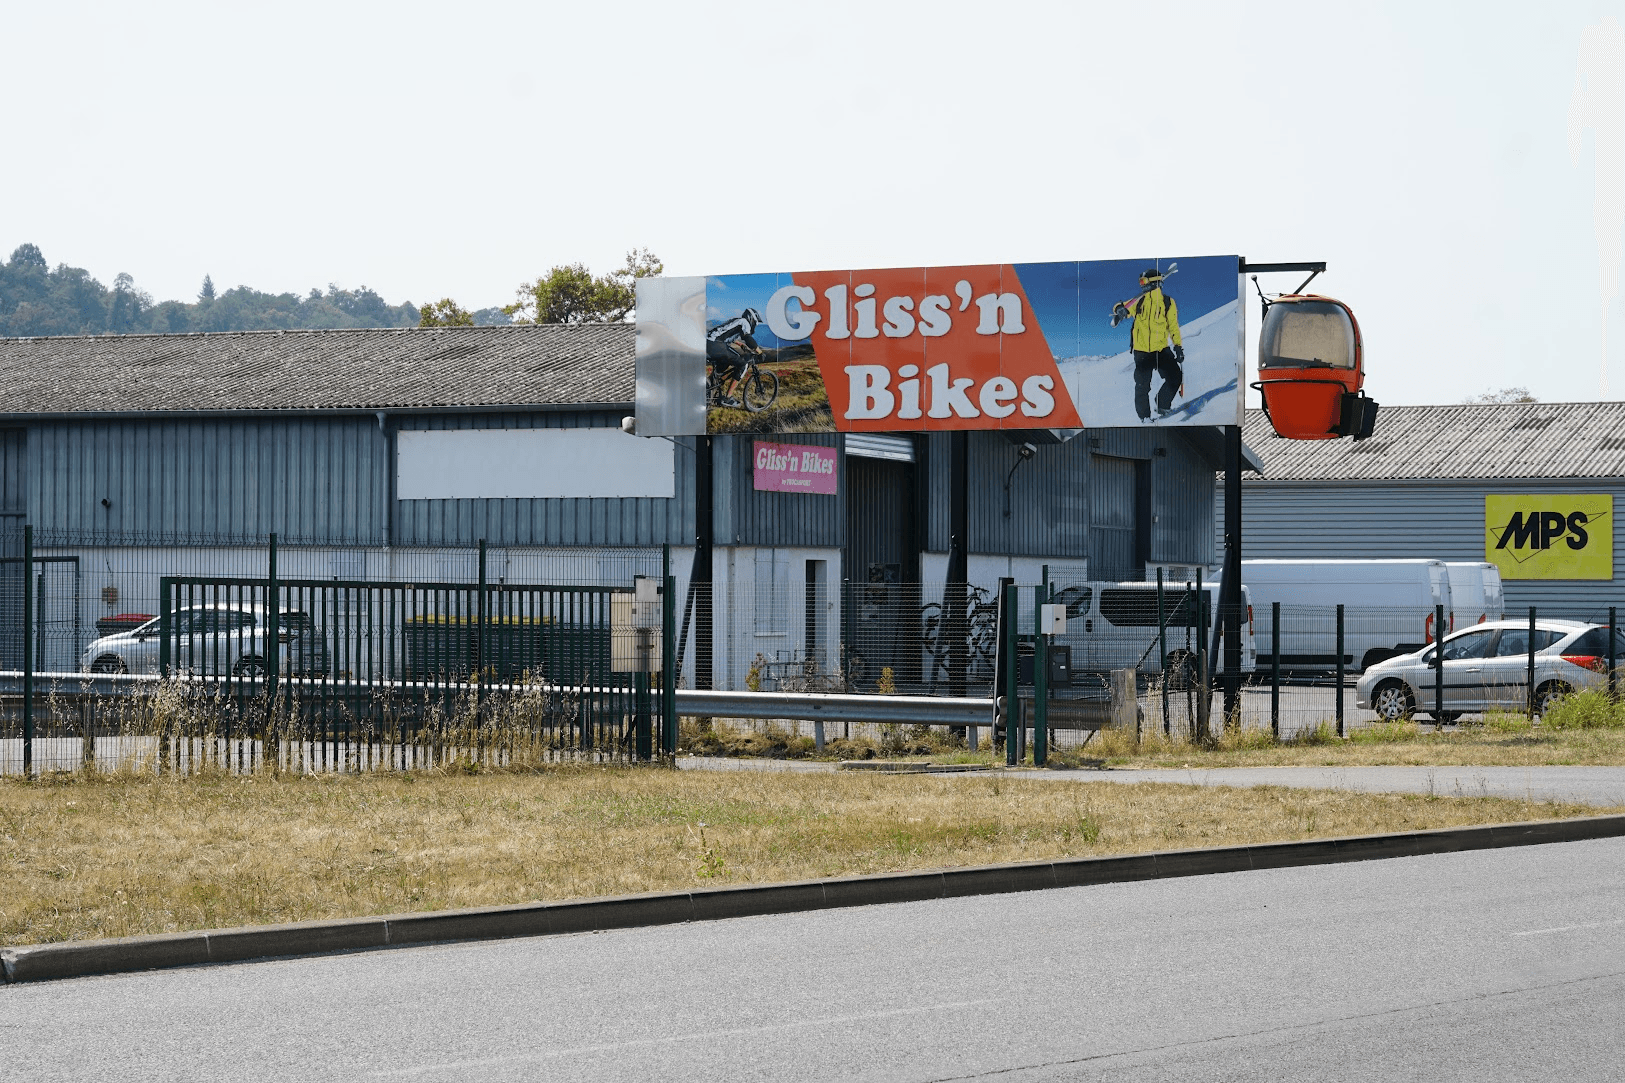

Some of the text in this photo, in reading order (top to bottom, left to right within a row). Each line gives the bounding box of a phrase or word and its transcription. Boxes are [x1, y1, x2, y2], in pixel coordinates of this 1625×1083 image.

[766, 280, 1026, 341] Gliss'n
[844, 363, 1056, 420] Bikes
[756, 448, 834, 475] Gliss'n Bikes
[1494, 511, 1589, 551] MPS
